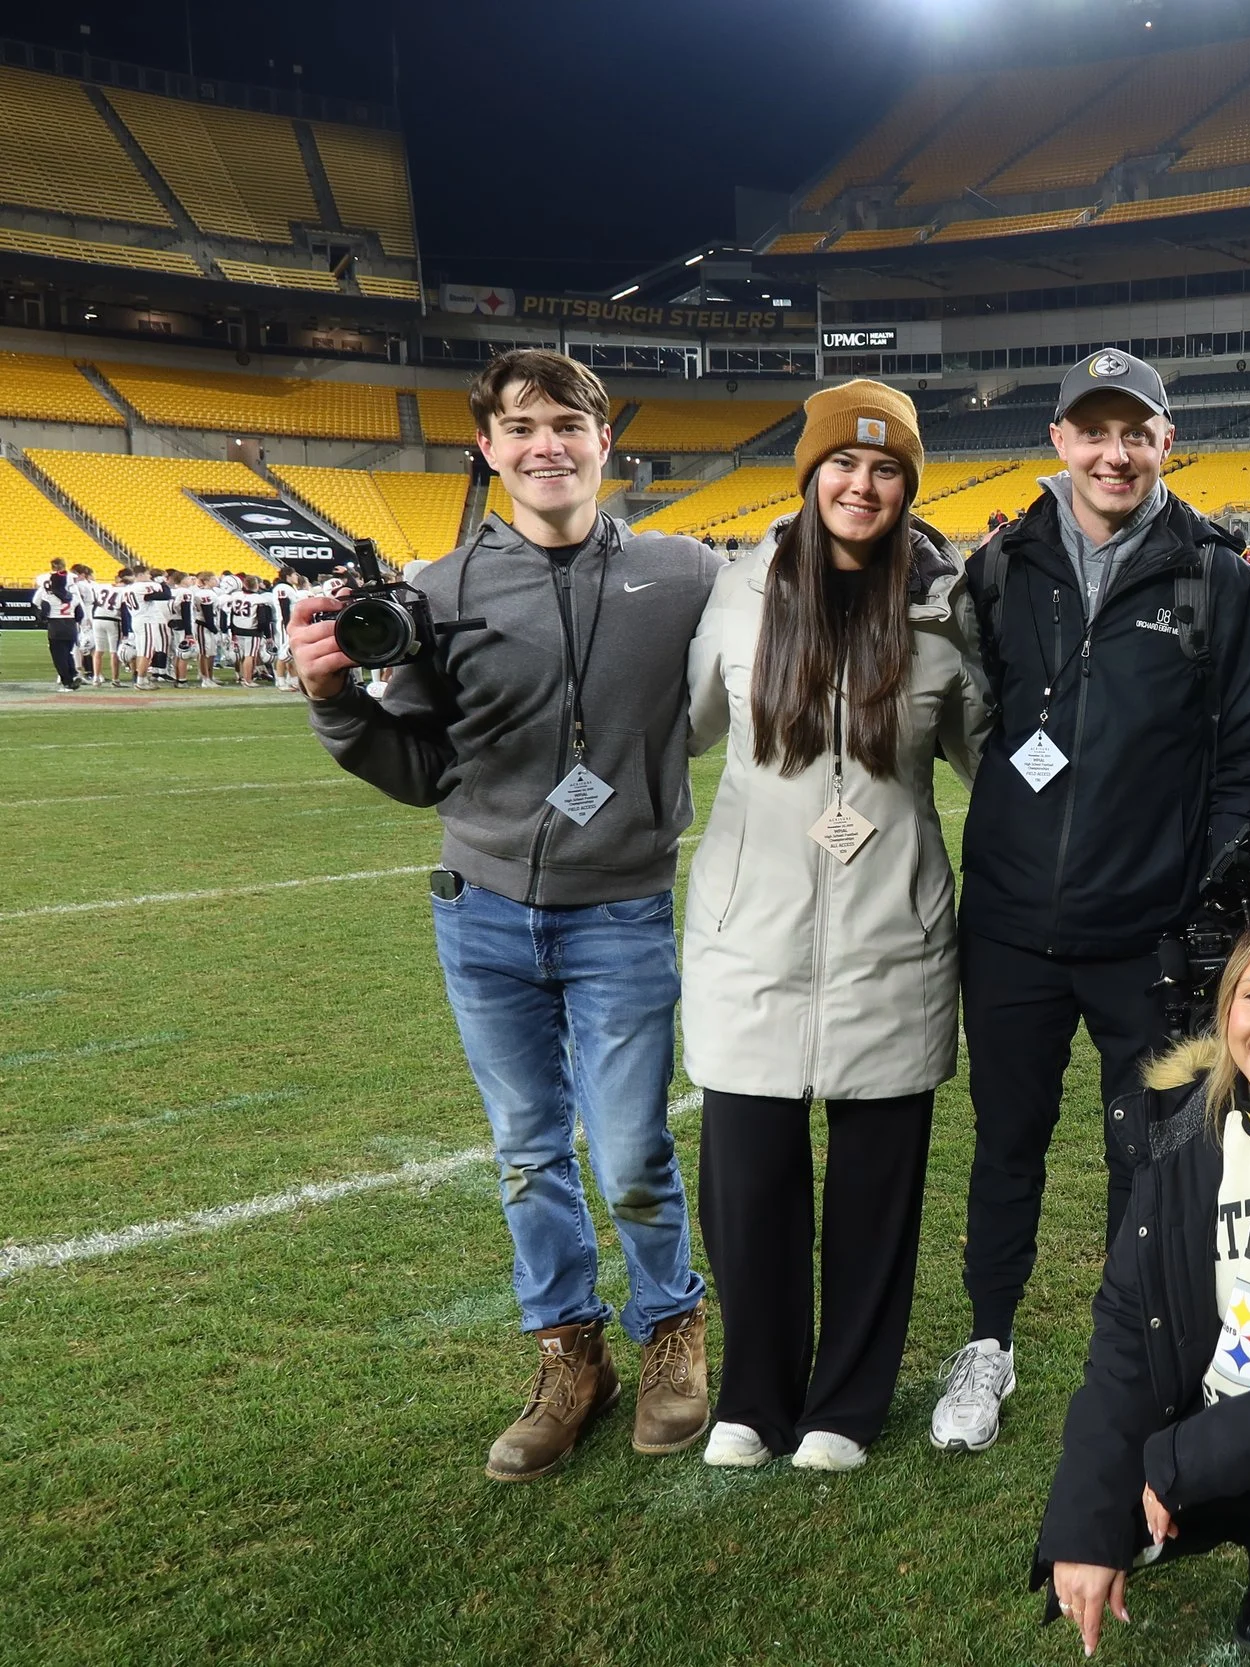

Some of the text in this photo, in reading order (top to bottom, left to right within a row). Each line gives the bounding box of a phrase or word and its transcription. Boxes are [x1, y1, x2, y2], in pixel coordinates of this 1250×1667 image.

[523, 296, 777, 329] PITTSBURGH STEELERS
[823, 333, 866, 347] UPMC
[243, 530, 330, 542] GEICO
[269, 546, 333, 559] GEICO
[100, 589, 118, 611] 34
[60, 602, 71, 616] 2
[1157, 608, 1172, 624] 08
[1136, 620, 1159, 631] ORCHARD
[1158, 624, 1172, 634] EIGHT
